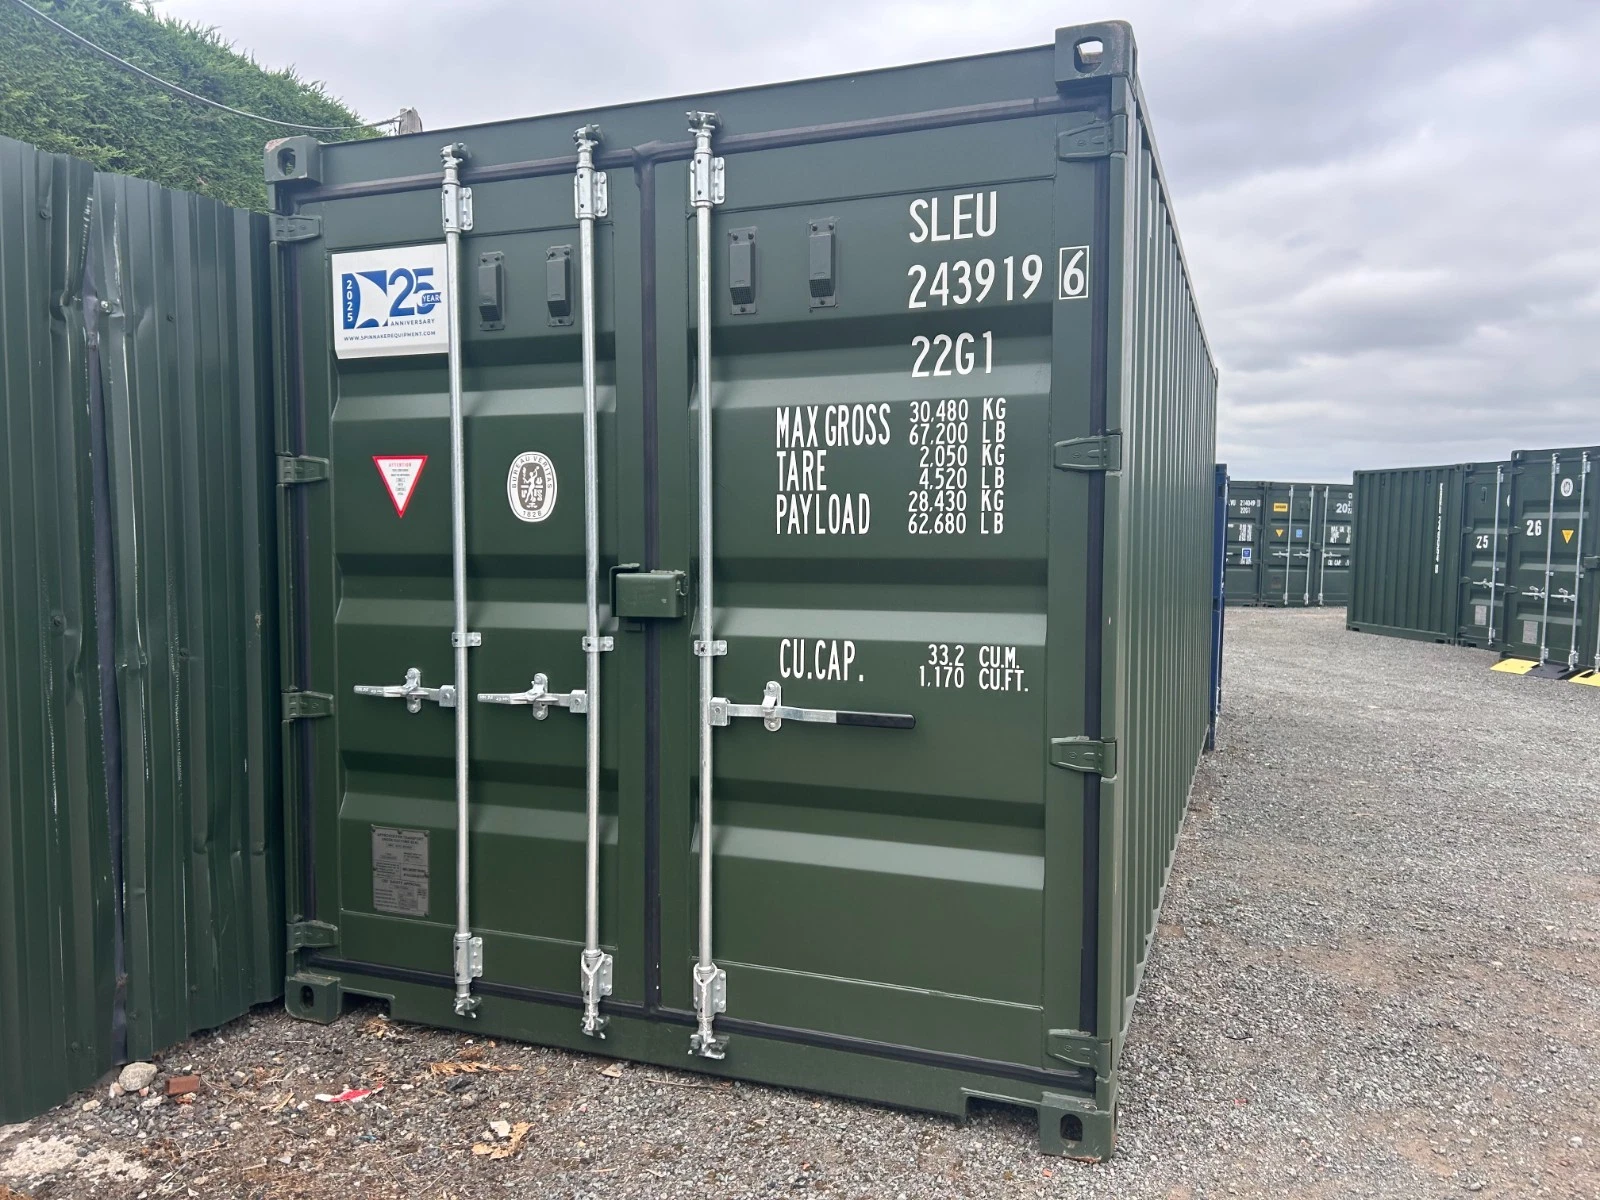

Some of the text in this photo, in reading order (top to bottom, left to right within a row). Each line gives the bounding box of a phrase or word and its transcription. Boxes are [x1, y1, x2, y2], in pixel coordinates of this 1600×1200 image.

[909, 190, 997, 243] SLEU
[907, 249, 1085, 309] 243919 6
[346, 279, 354, 322] 2025
[388, 267, 436, 318] 25
[422, 294, 440, 303] YEAR
[390, 318, 435, 327] ANNIVERSARY
[343, 330, 436, 342] WWW.SPINNAKEREQUIPMENT.COM
[911, 331, 992, 377] 22G1
[909, 398, 1006, 423] 30,480 KG
[776, 402, 891, 448] MAX GROSS
[909, 421, 1006, 446] 67,200 LB
[919, 444, 1005, 468] 2,050 KG
[512, 456, 552, 488] BUREAU VERITAS
[776, 450, 827, 491] TARE
[919, 467, 1005, 490] 4,520 LB
[776, 493, 871, 535] PAYLOAD
[908, 490, 1004, 513] 28,430 KG
[908, 512, 1004, 535] 62,680 LB
[1526, 519, 1542, 537] 26
[1475, 534, 1489, 549] 25
[927, 643, 964, 667] 33.2
